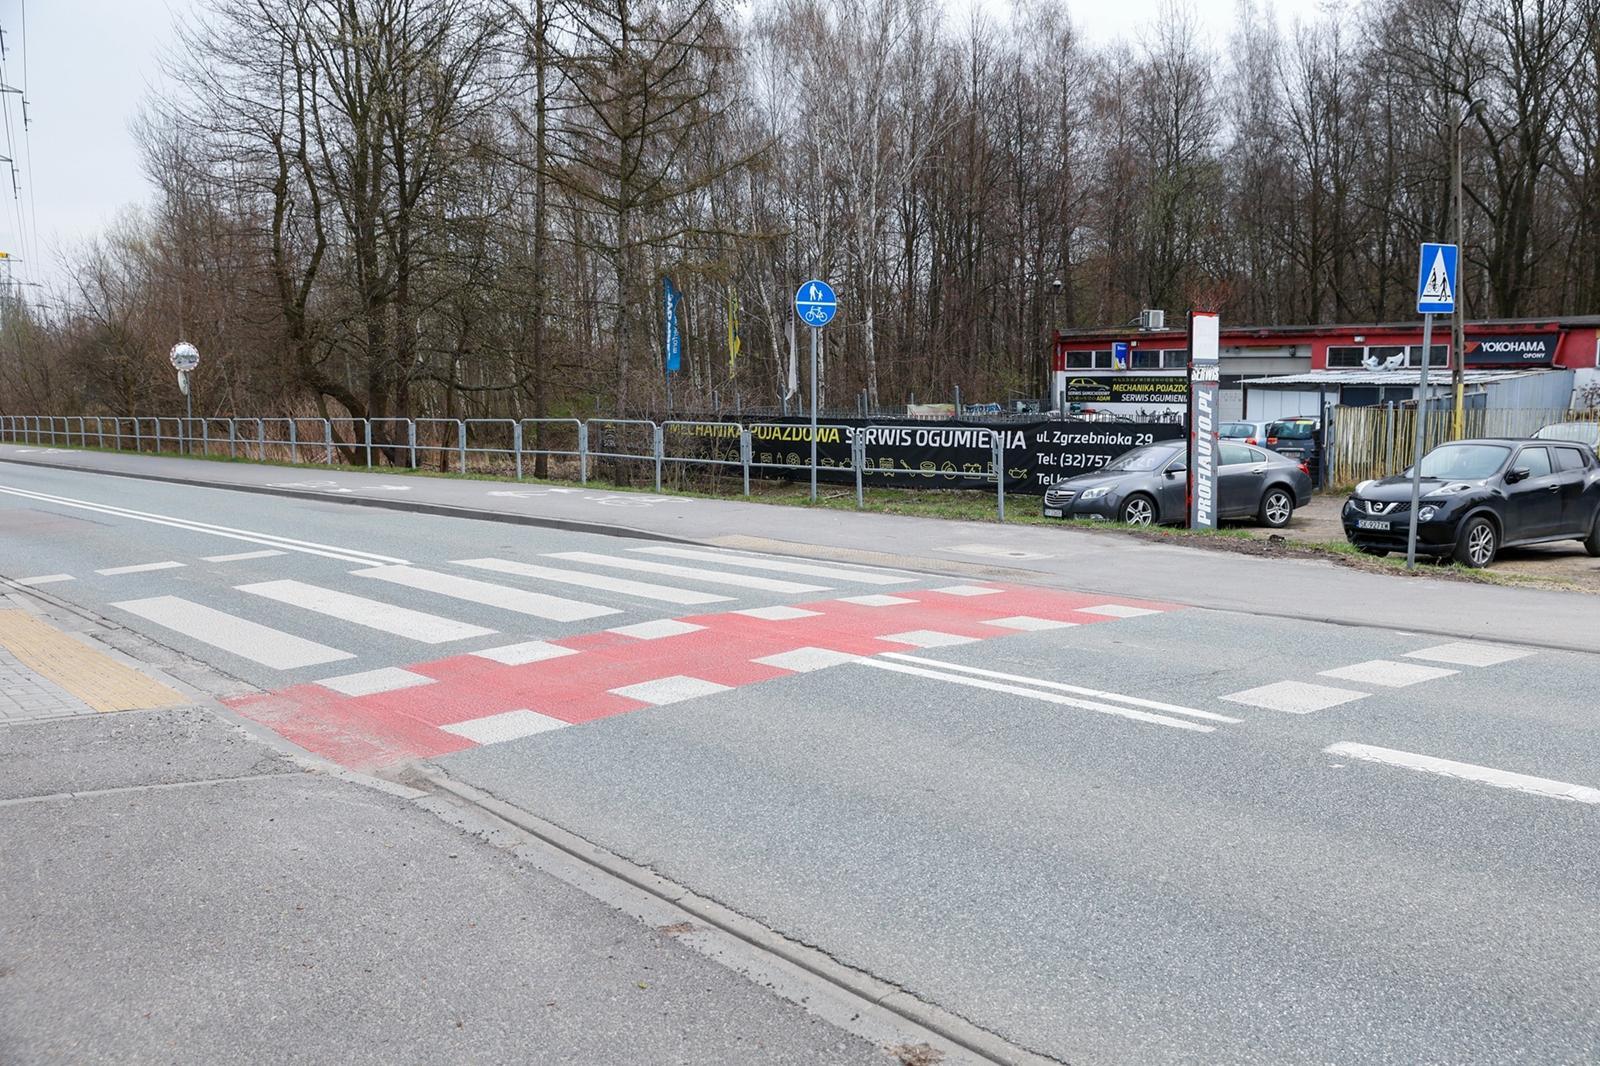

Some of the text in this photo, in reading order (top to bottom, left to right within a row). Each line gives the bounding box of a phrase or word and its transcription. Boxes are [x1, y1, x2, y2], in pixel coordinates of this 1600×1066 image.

[1481, 341, 1545, 352] YOKOHAMA
[1113, 383, 1154, 392] MECHANIKA
[1121, 393, 1187, 403] SERWIS OGUMIENI
[845, 427, 911, 447] SERWIS
[916, 430, 1027, 449] OGUMIENIA
[1052, 431, 1132, 446] Zgrzebnioka
[1135, 433, 1153, 445] 29
[1036, 453, 1112, 467] Tel: (32)757
[1197, 390, 1211, 525] PROFIAUTO.PL
